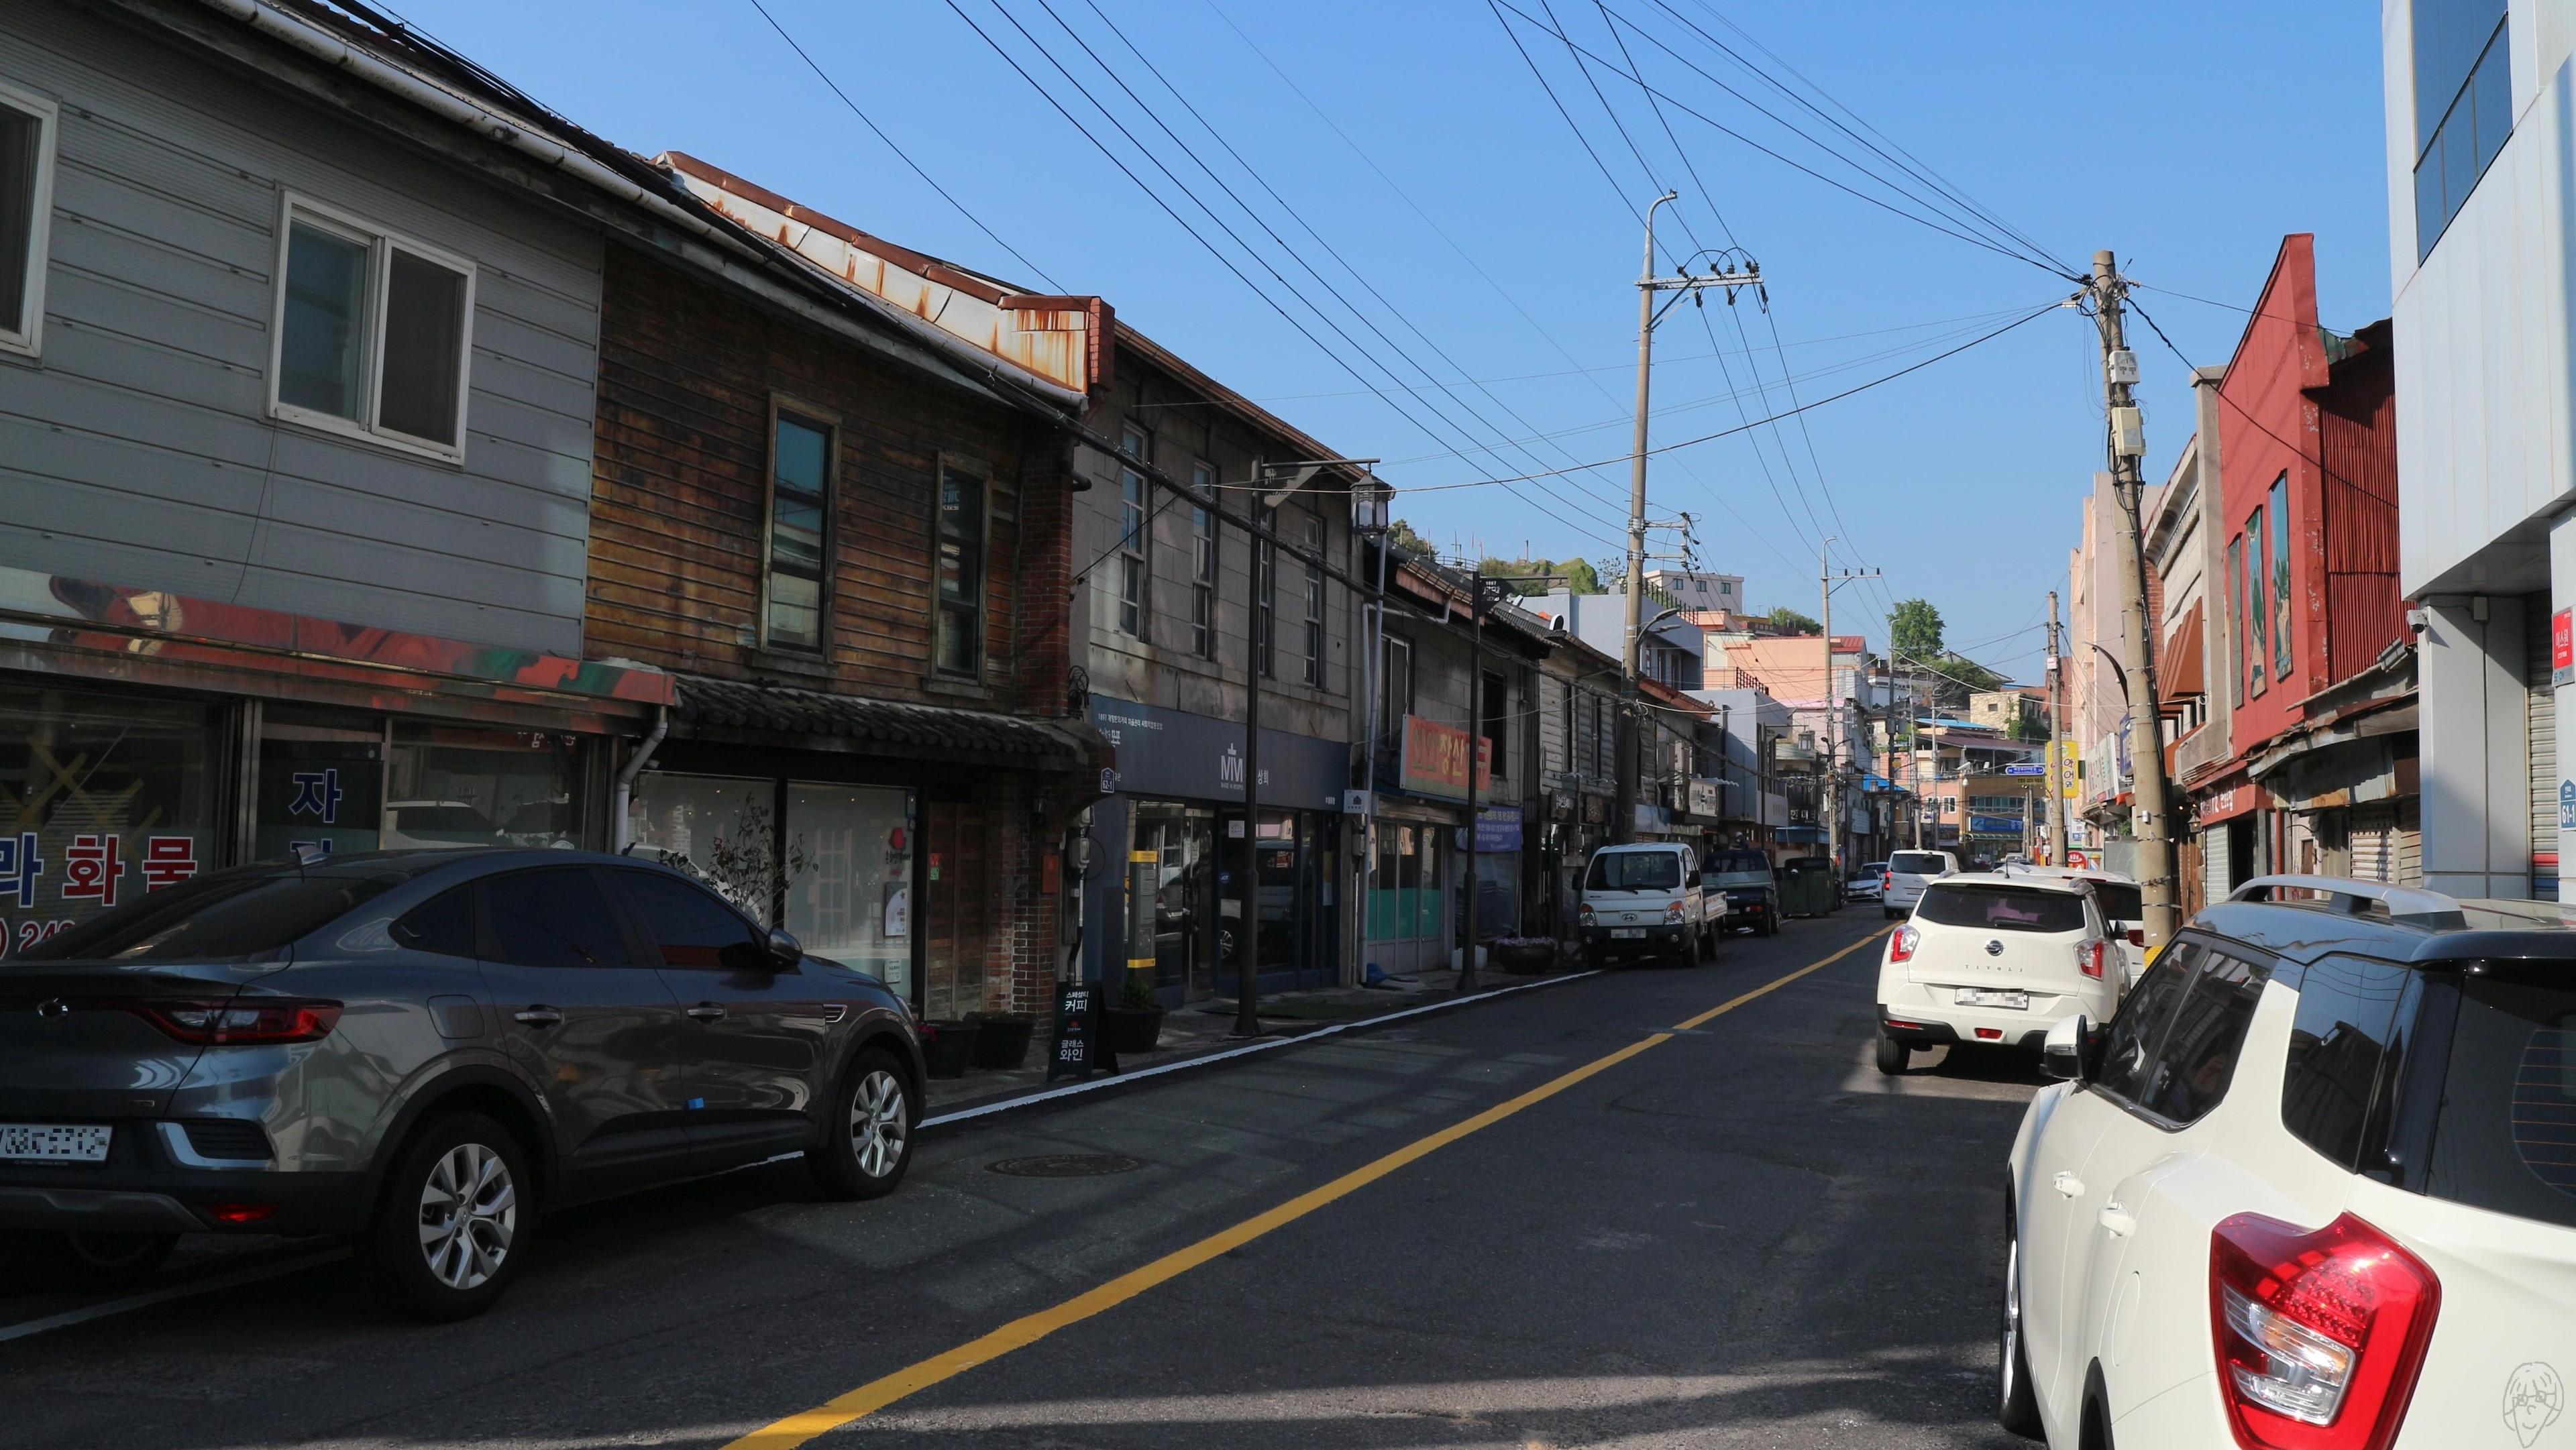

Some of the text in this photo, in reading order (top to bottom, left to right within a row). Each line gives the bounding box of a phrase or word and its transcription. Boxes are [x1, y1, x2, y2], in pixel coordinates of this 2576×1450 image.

[1102, 779, 1113, 790] 62-1
[1258, 769, 1269, 786] 상회
[2562, 804, 2575, 824] 61-1
[1965, 964, 2023, 972] TIVOLI
[1065, 990, 1089, 999] 스페셜티
[1065, 998, 1087, 1013] 커피
[1059, 1048, 1083, 1062] 와인
